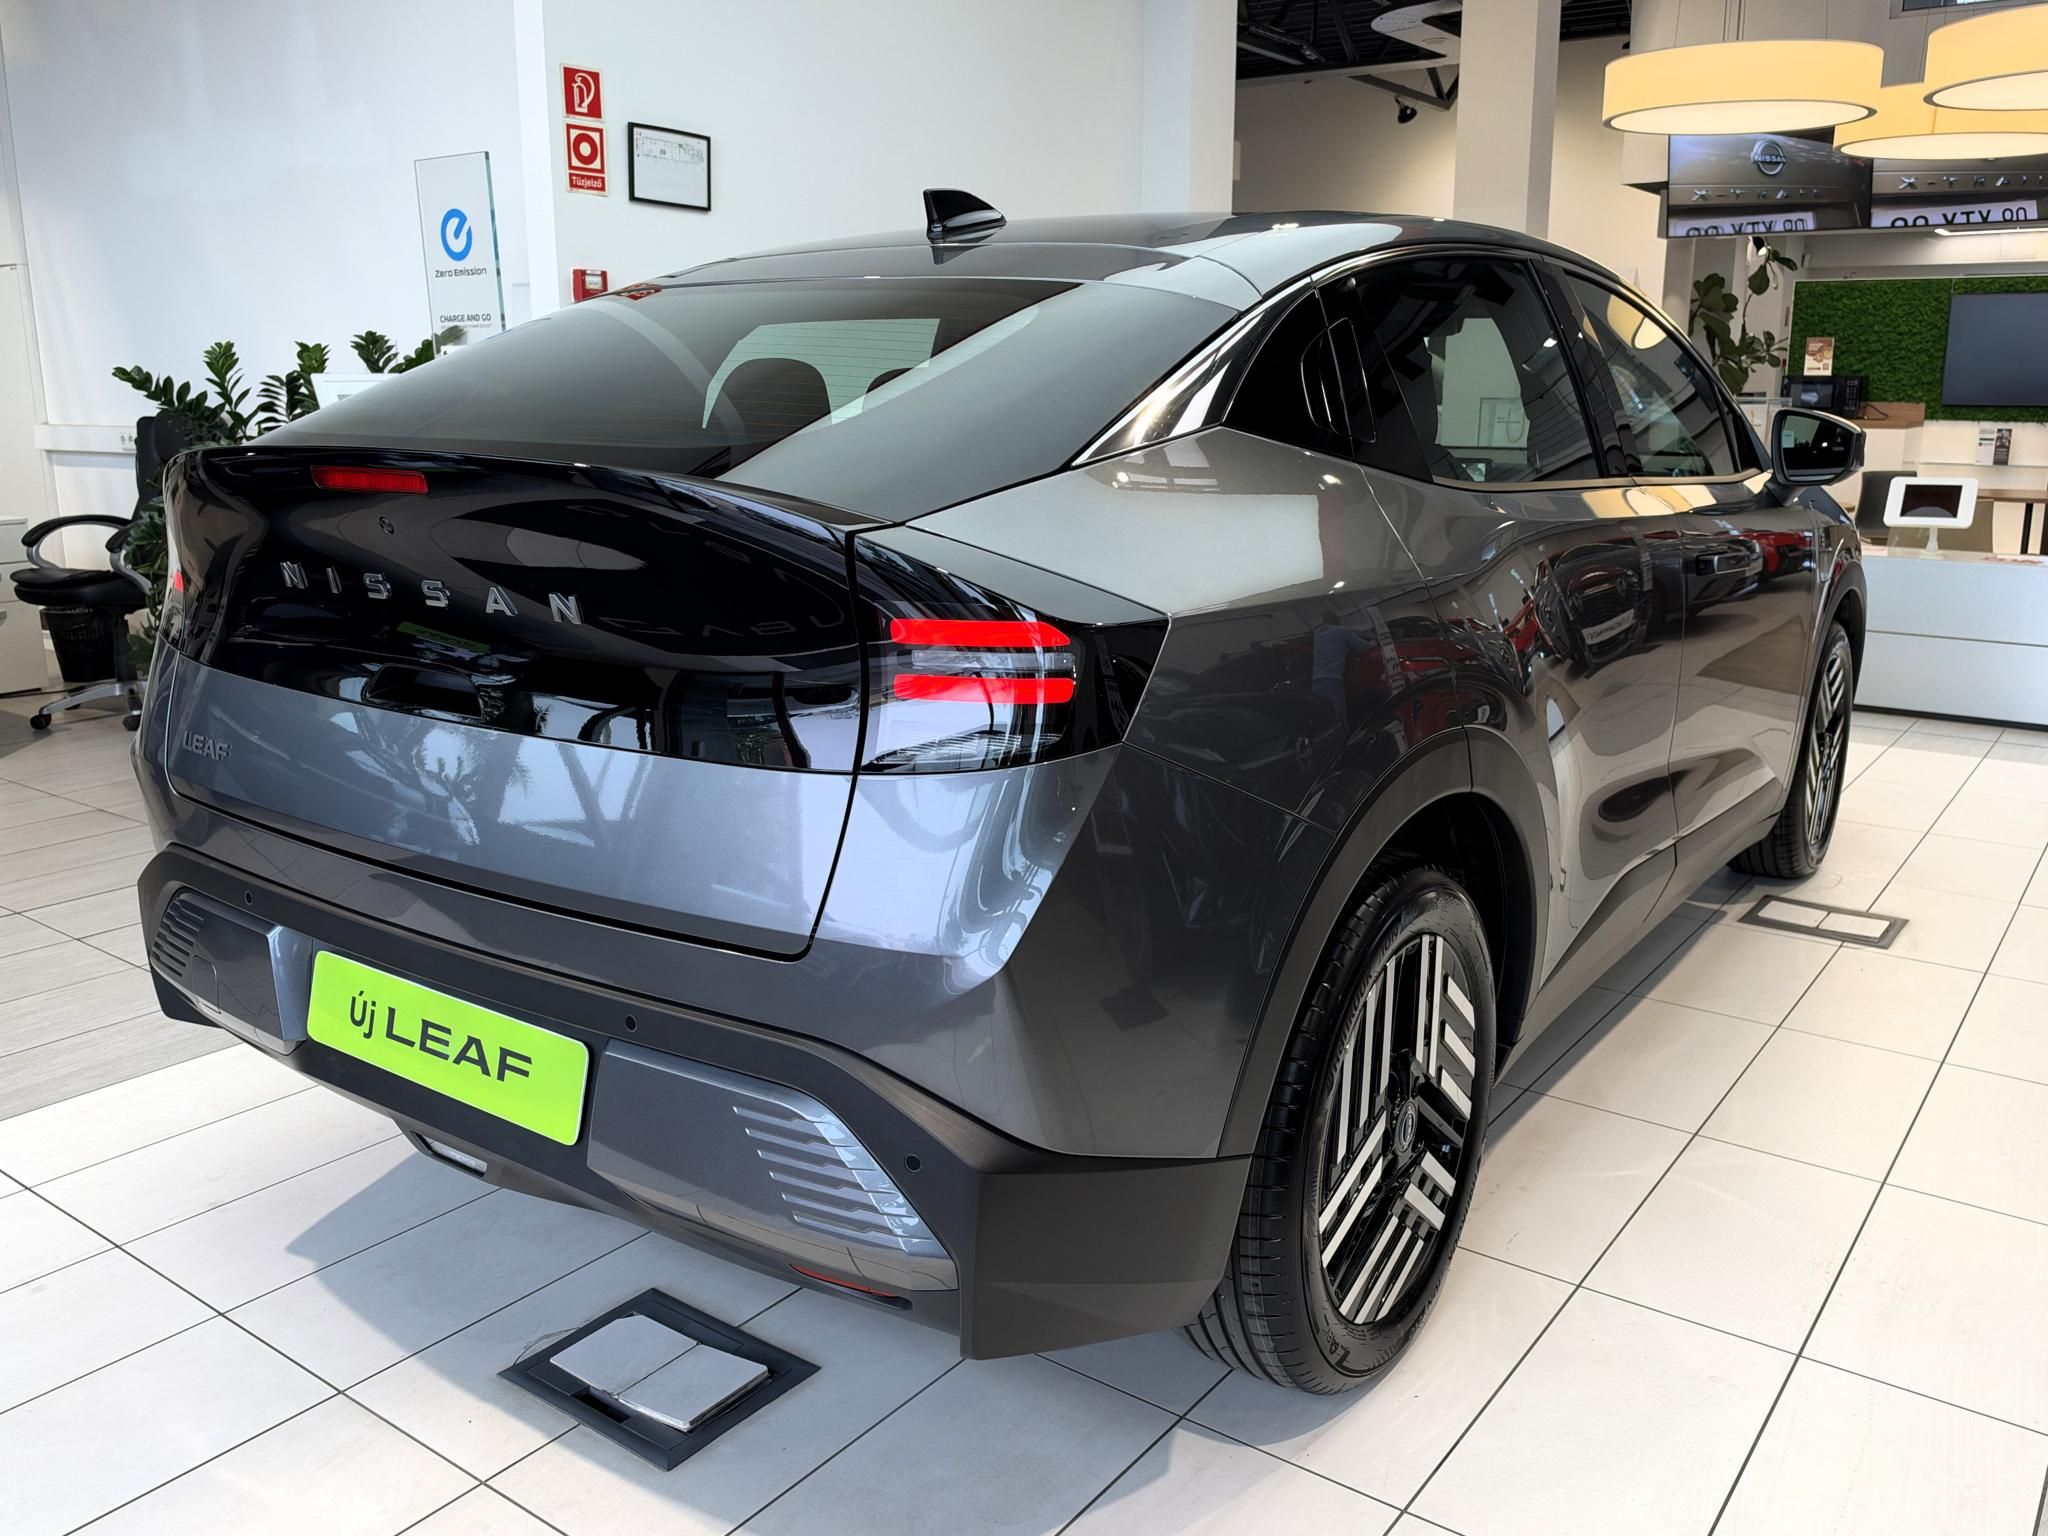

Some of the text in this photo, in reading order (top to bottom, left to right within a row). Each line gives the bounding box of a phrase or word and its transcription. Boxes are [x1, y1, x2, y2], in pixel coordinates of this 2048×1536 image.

[435, 266, 487, 278] Zero Emission
[440, 313, 492, 323] CHARGE AND GO
[280, 561, 583, 626] NISSAN
[183, 730, 233, 761] LEAF
[350, 990, 533, 1083] Új LEAF
